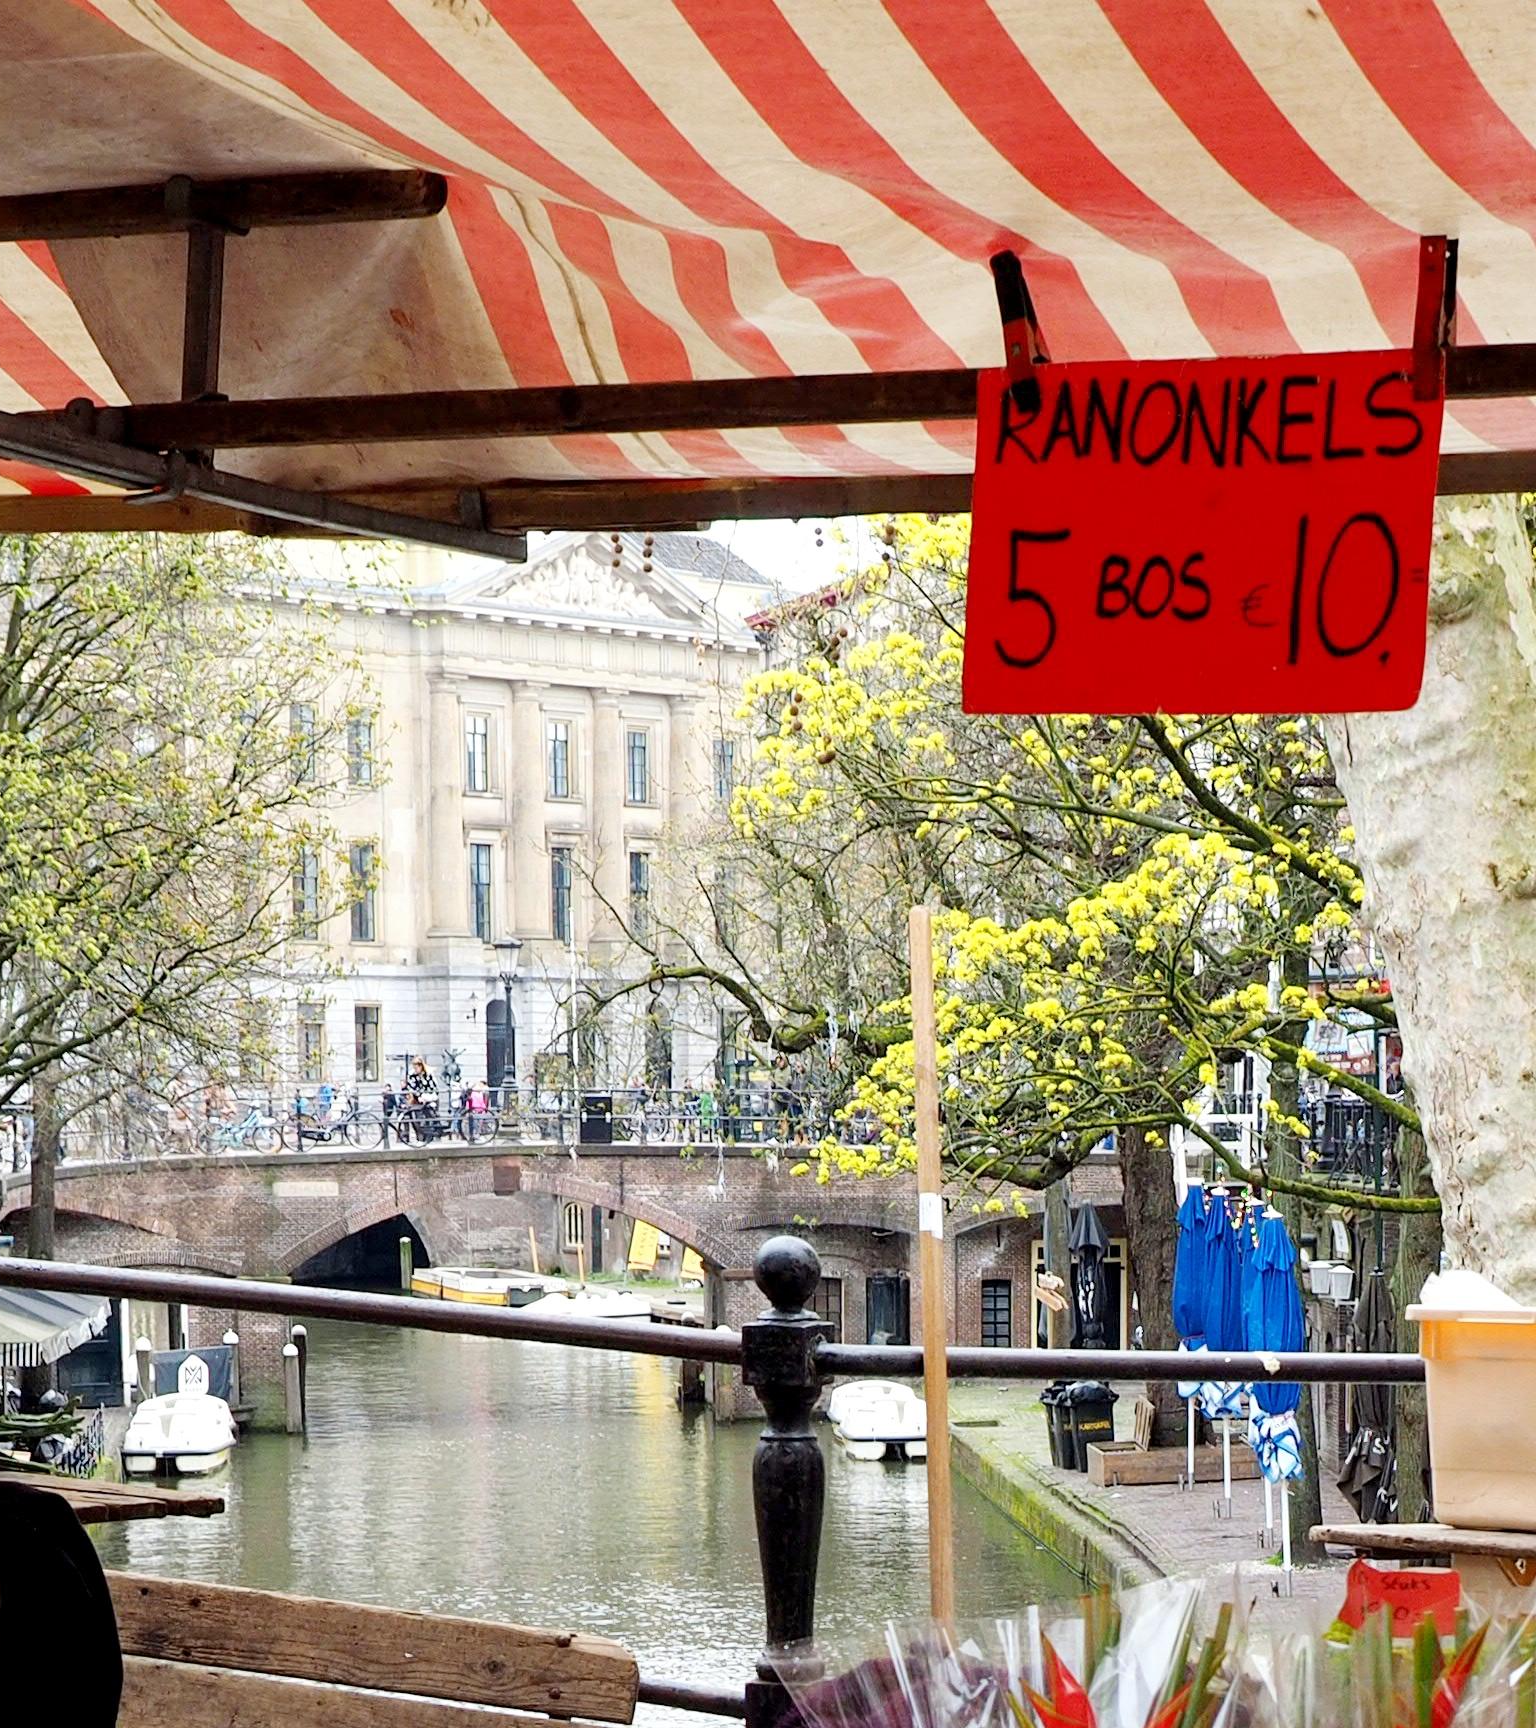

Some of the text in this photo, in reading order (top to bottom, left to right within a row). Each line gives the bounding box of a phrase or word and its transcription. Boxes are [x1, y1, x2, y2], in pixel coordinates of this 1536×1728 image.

[994, 372, 1424, 468] RANONKELS
[994, 528, 1071, 668] 5
[1095, 552, 1212, 621] BOS
